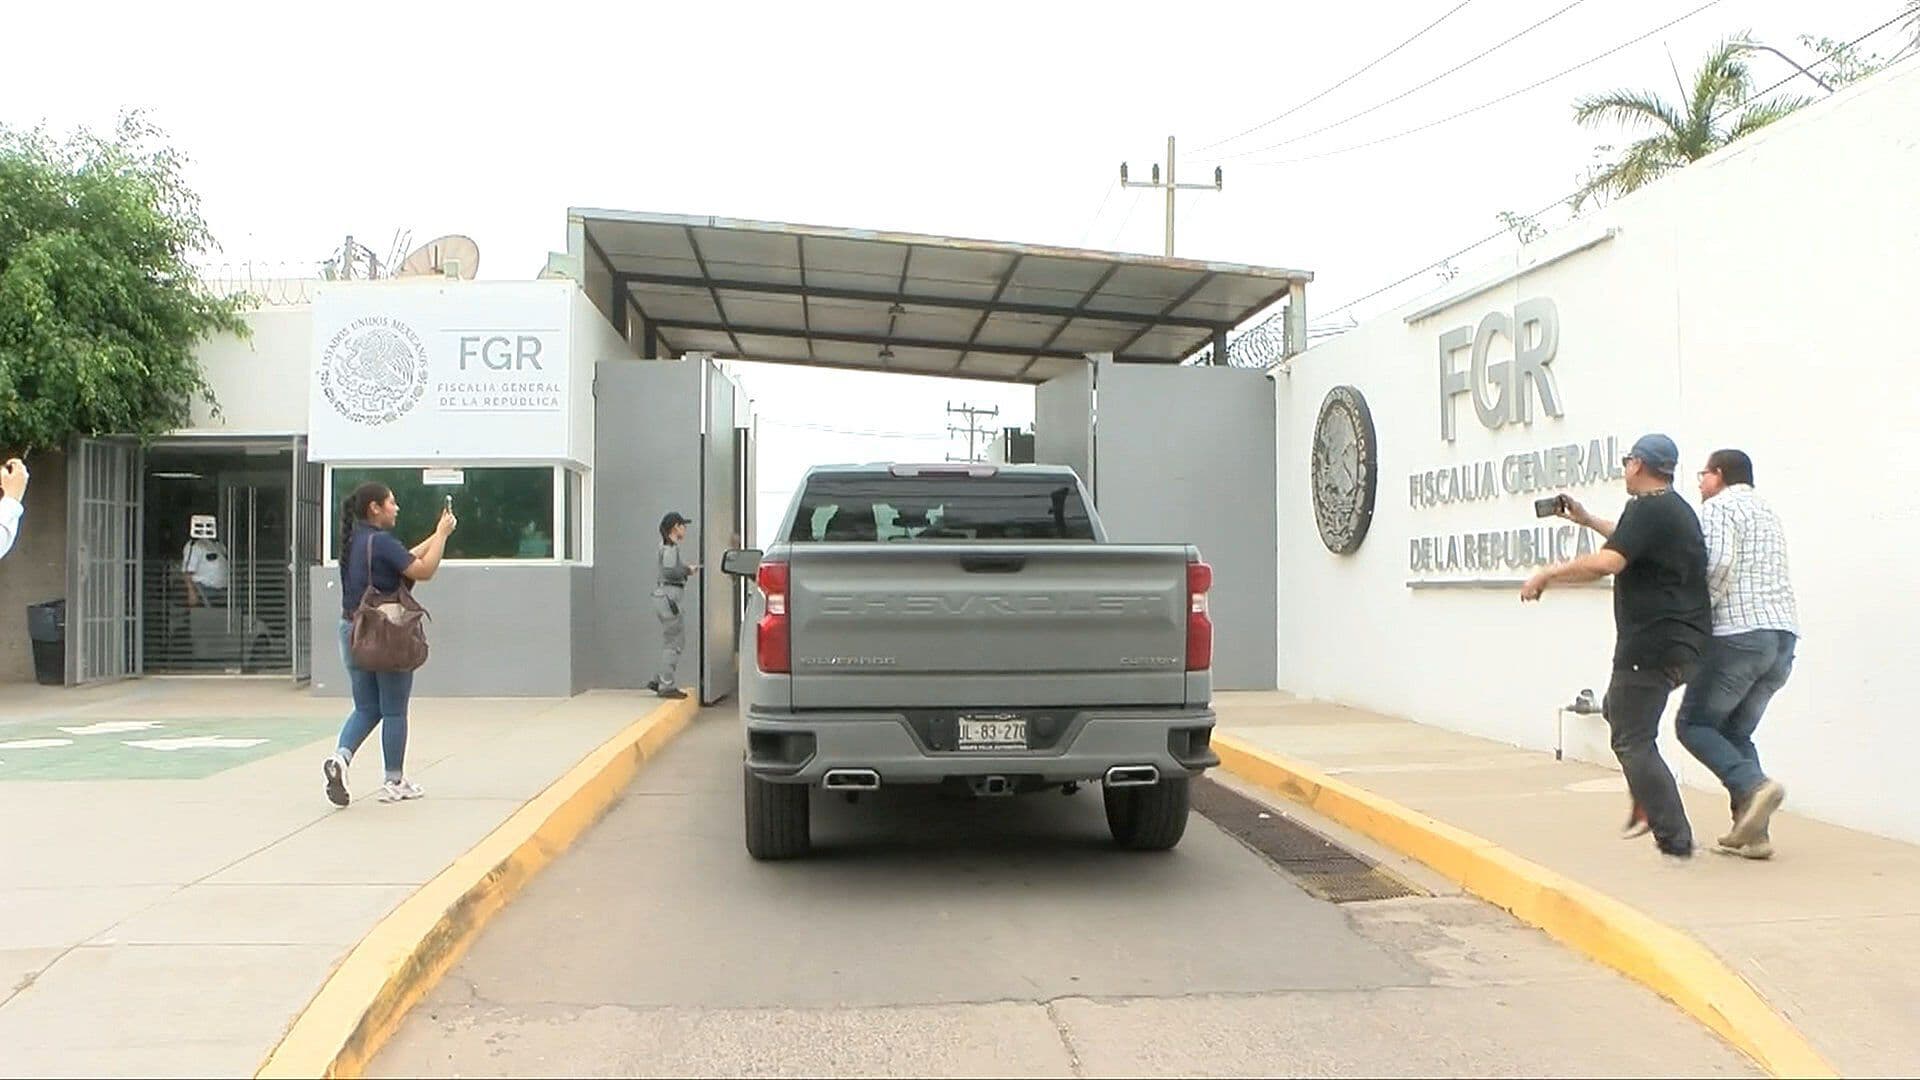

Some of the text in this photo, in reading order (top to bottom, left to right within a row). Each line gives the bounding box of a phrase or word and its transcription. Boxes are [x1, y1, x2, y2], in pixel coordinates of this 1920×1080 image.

[459, 335, 543, 371] FGR
[1438, 296, 1565, 442] FGR
[437, 383, 561, 393] FISCALIA GENERAL
[440, 397, 559, 407] DE LA REPUBLICA
[1409, 436, 1624, 509] FISCALIA GENERAL
[1410, 526, 1597, 572] DE LA REPUBLICA
[821, 593, 1162, 615] CHEVROLET
